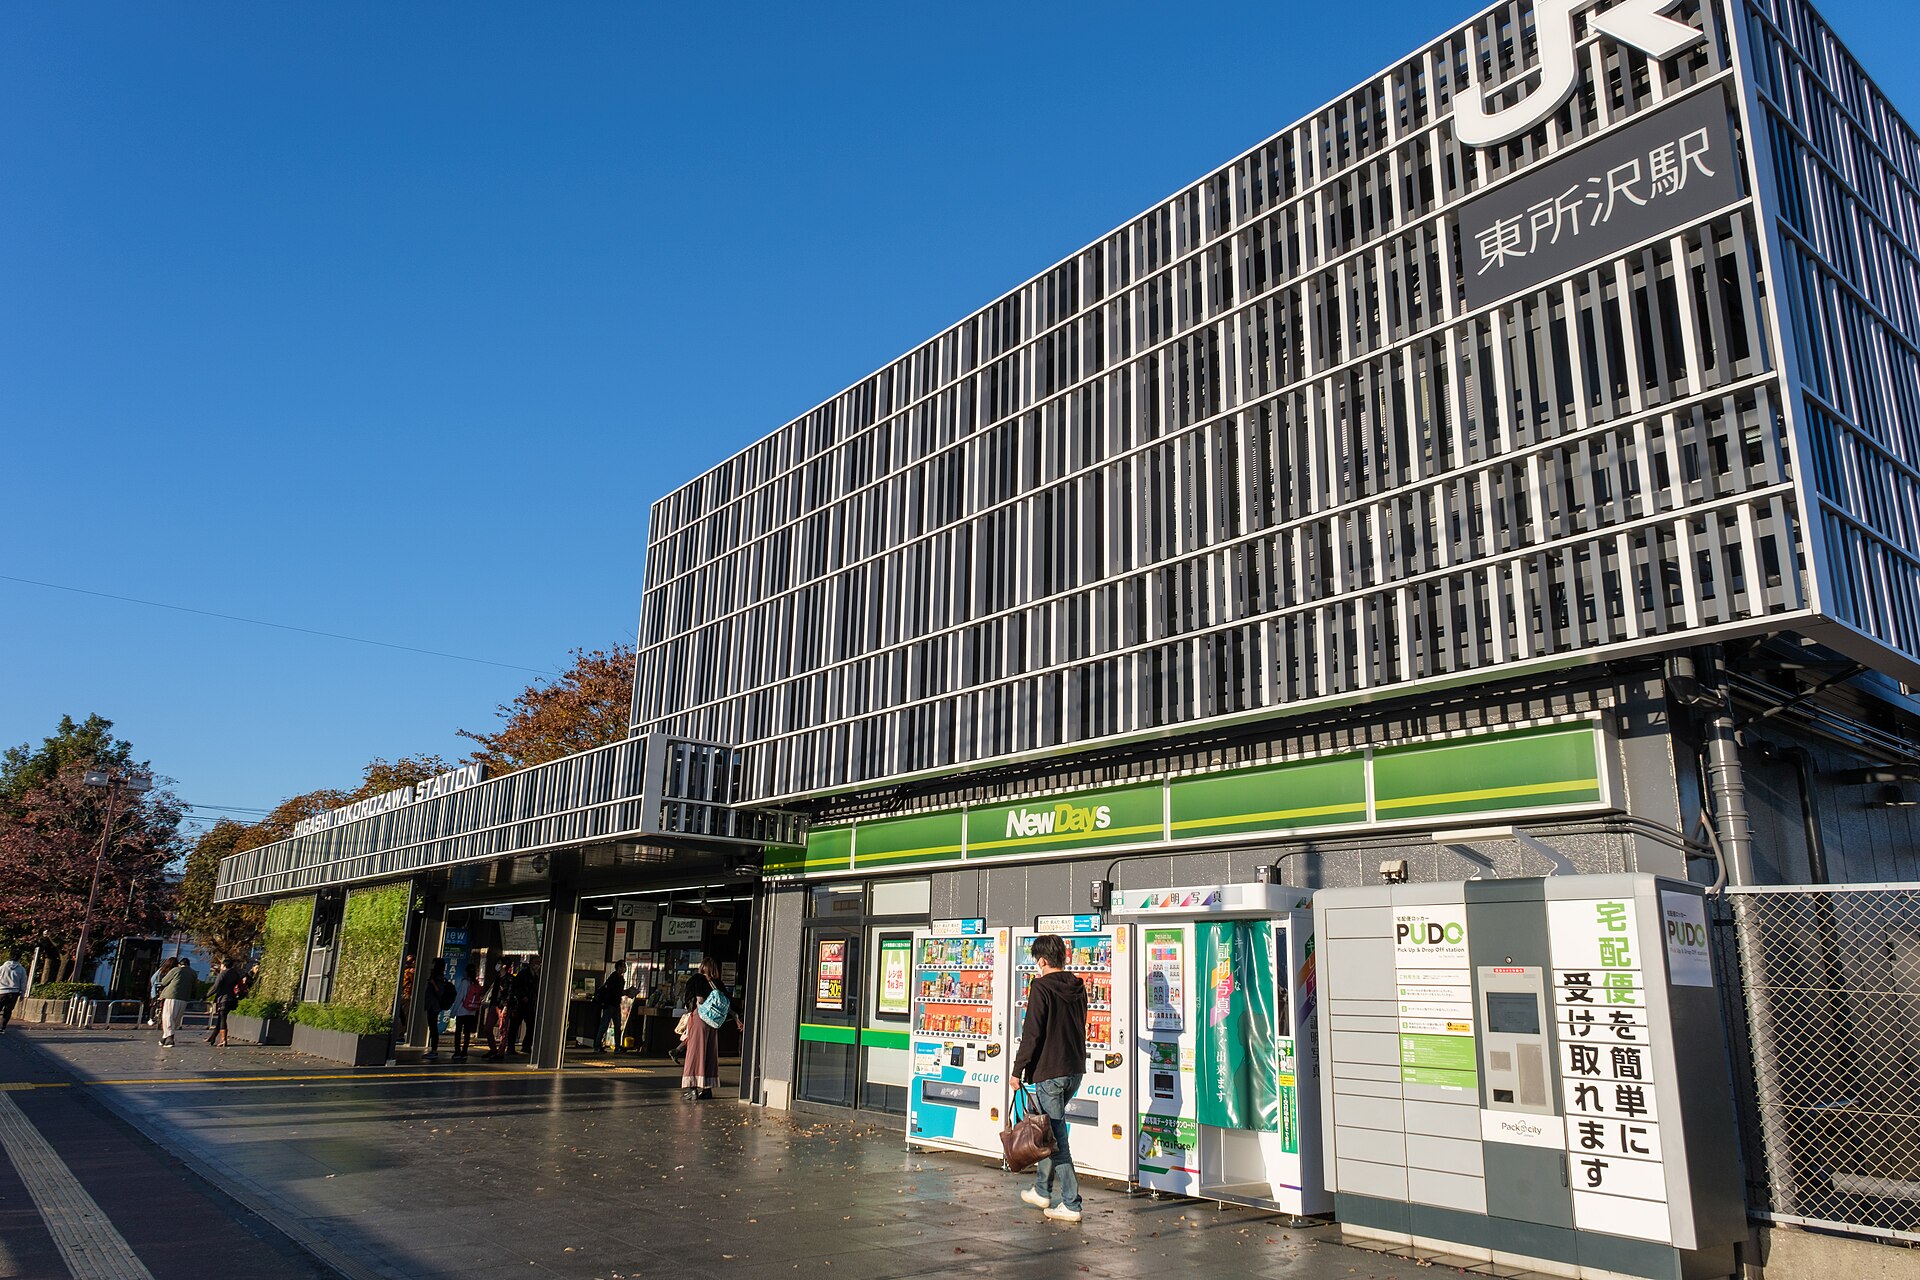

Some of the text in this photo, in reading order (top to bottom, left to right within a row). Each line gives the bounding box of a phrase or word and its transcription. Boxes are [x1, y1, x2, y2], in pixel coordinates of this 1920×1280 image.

[1474, 127, 1715, 276] 東所沢駅
[293, 763, 483, 837] HIGASHI TOKOROZAWA STATION
[1005, 803, 1111, 838] NewDays
[1151, 891, 1222, 906] 証明写真
[1396, 922, 1464, 944] PUDO
[1667, 920, 1706, 947] PUDO
[1596, 901, 1649, 1154] 宅配便を簡単に
[971, 1072, 1000, 1084] acure
[1087, 1084, 1122, 1098] acure
[1563, 972, 1609, 1188] 受け取れます
